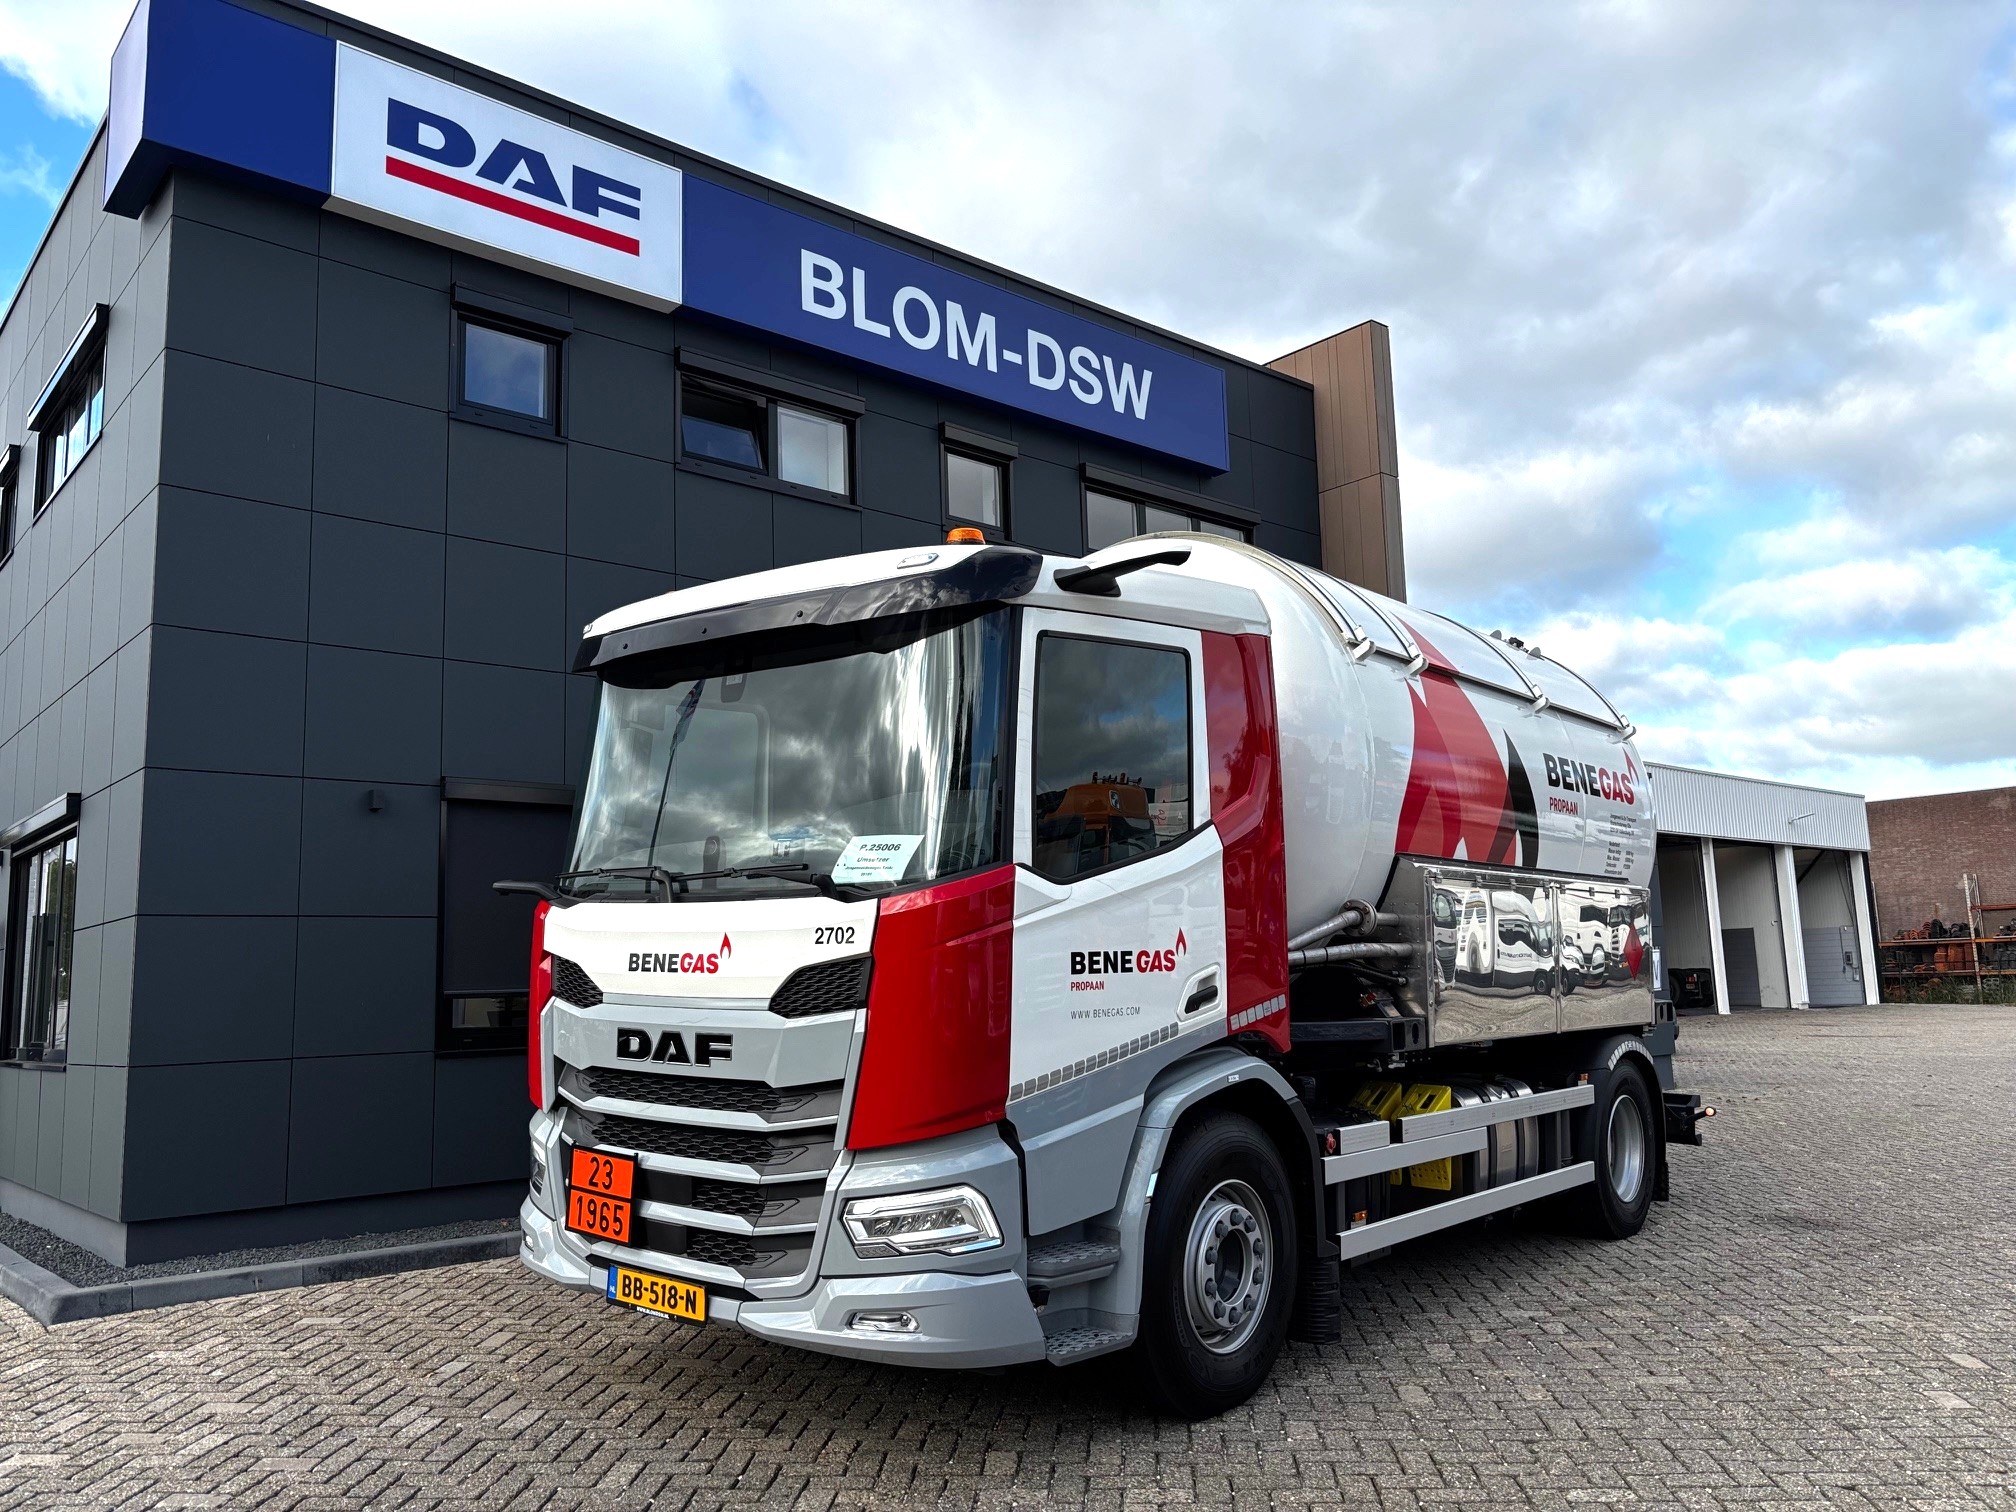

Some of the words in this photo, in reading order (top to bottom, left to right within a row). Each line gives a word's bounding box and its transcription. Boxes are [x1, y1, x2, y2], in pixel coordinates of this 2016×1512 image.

[386, 97, 641, 221] DAF
[800, 248, 1153, 421] BLOM-DSW
[1543, 753, 1635, 806] BENEGAS
[1549, 796, 1579, 815] PROPAAN
[815, 927, 854, 944] 2702
[628, 952, 719, 974] BENEGAS
[1071, 981, 1104, 991] PROPAAN
[1071, 1007, 1139, 1019] WWW.BENEGAS.COM
[616, 1027, 734, 1067] DAF
[588, 1156, 613, 1190] 23
[576, 1195, 625, 1236] 1965
[609, 1285, 616, 1293] NL
[622, 1274, 697, 1315] BB-518-N
